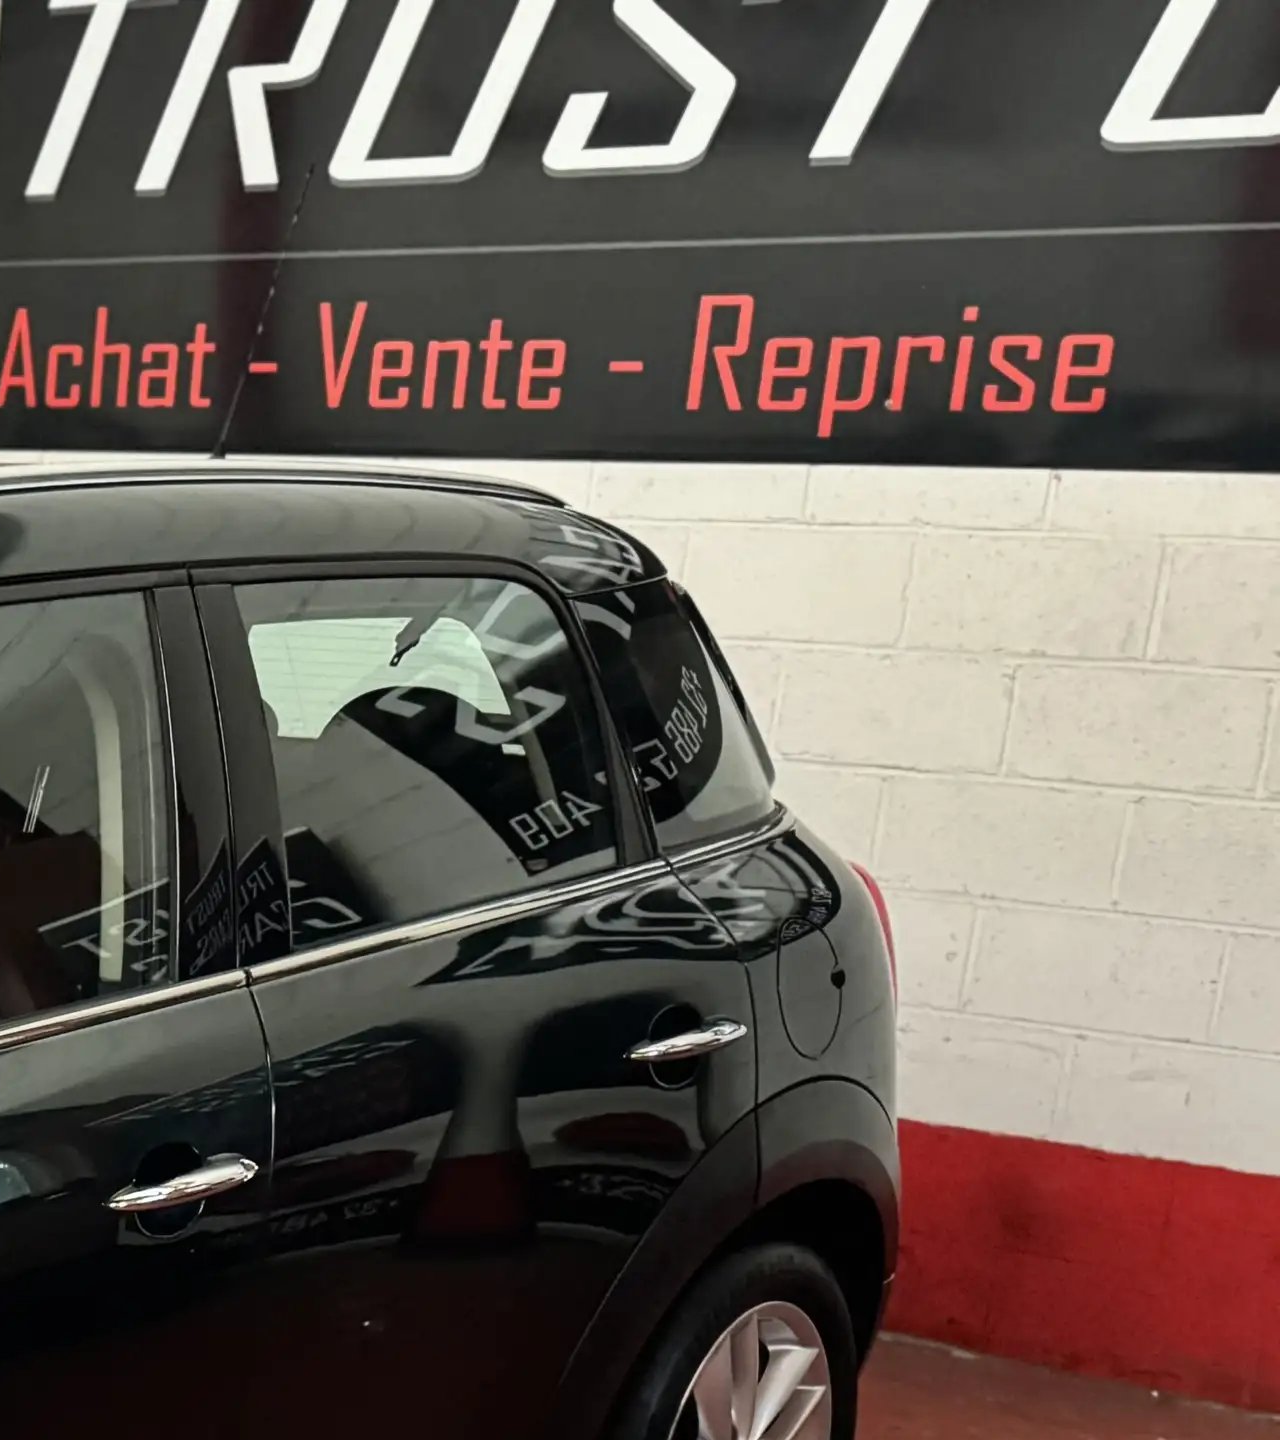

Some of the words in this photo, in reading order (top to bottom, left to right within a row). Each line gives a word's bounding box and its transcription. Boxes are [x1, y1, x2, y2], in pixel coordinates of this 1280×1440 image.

[24, 0, 932, 198] TRUST
[318, 301, 567, 411] Vente
[685, 294, 1116, 438] Reprise
